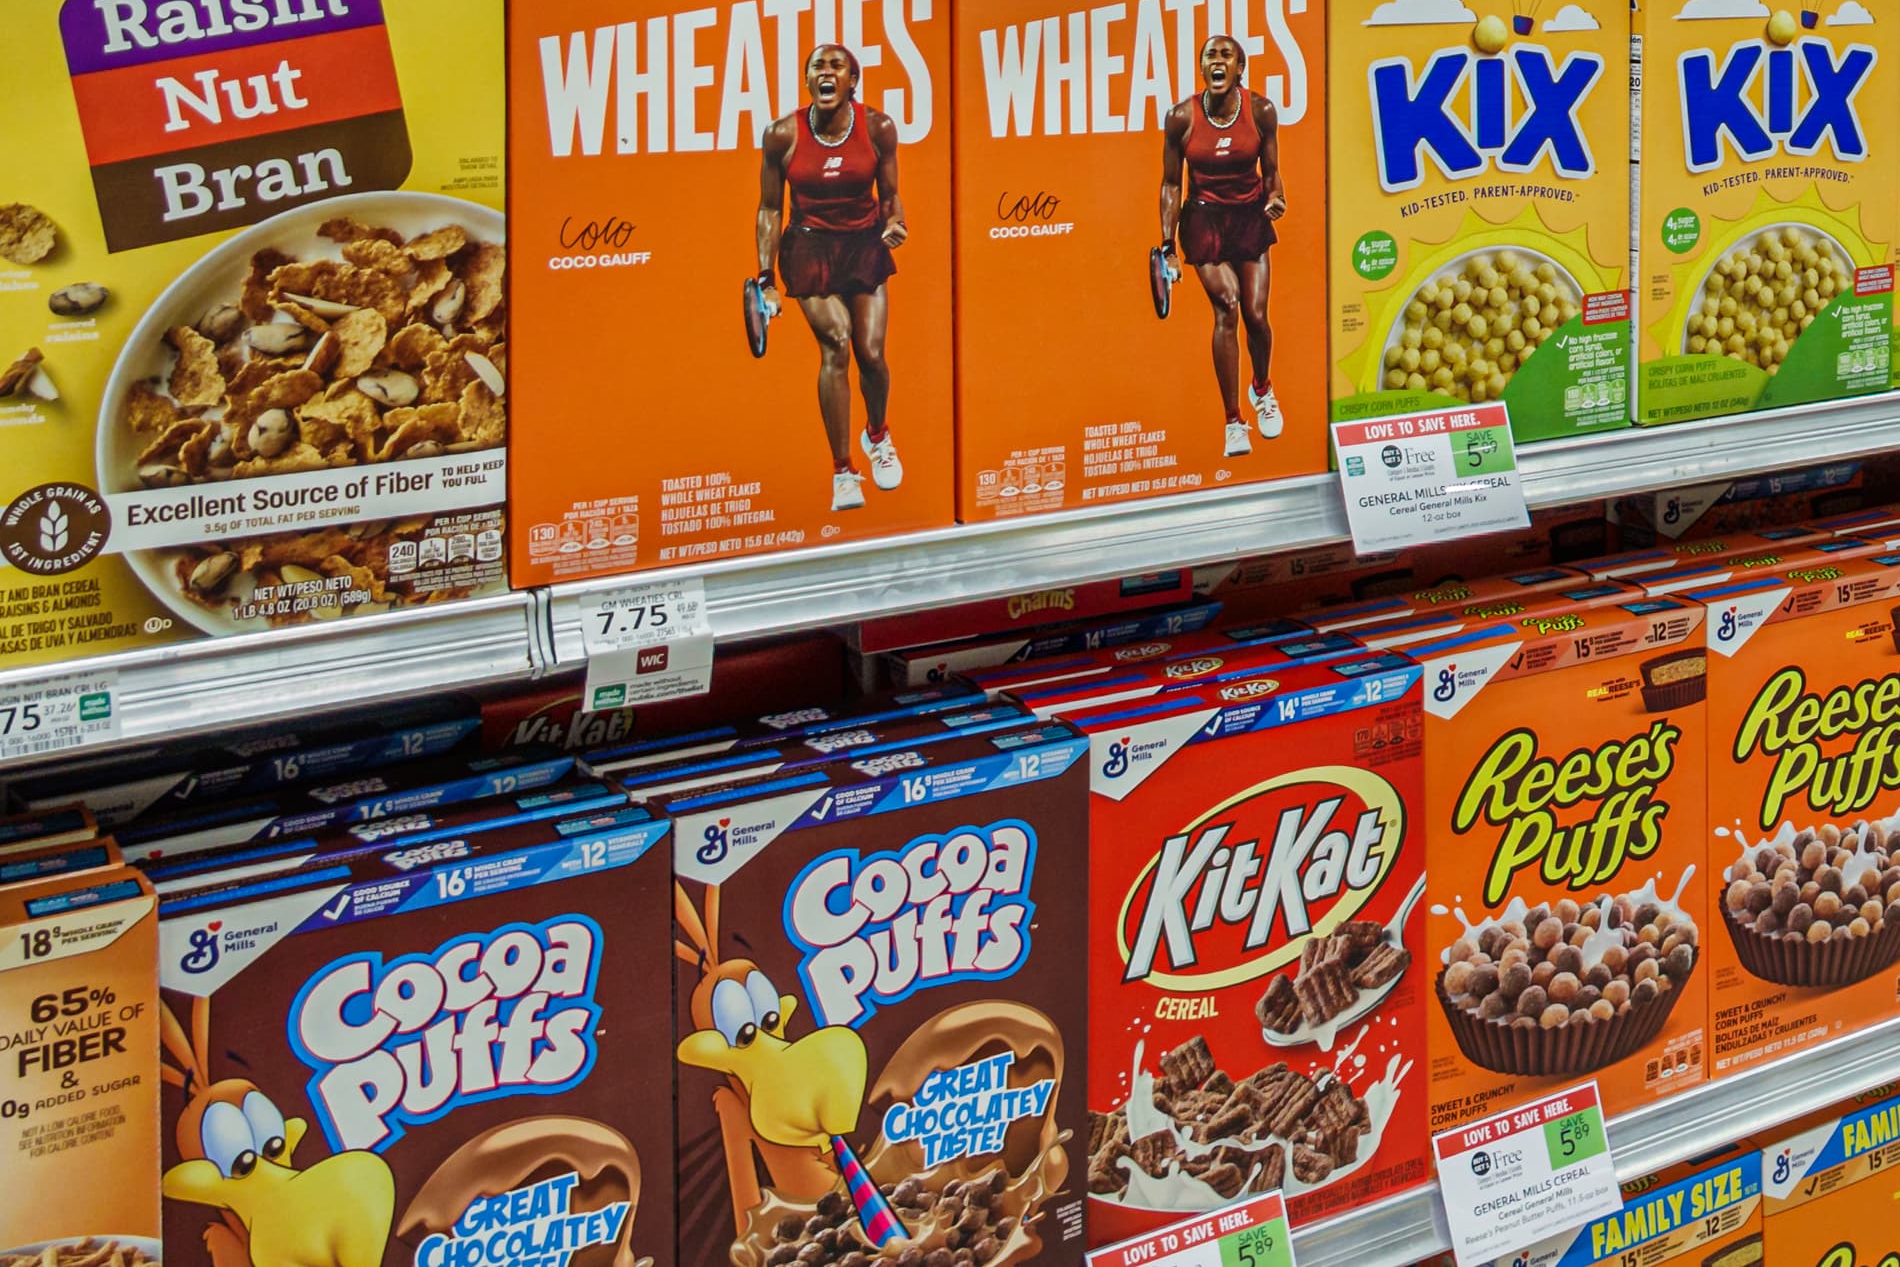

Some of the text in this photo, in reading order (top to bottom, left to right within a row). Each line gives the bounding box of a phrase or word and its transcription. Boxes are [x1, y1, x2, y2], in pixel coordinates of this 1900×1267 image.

[155, 60, 308, 133] Nut
[154, 146, 352, 221] Bran
[1400, 184, 1578, 219] KID-TESTED. PARENT-APPROVED.
[549, 252, 651, 270] COCO GAUFF
[442, 459, 505, 477] TO HELP KEEP
[442, 474, 487, 489] YOU FULL
[6, 487, 102, 526] WHOLE GRAIN AS
[128, 471, 434, 527] Excellent Source of Fiber
[28, 531, 102, 570] INGREDIENT
[597, 604, 669, 634] 7.75
[1454, 721, 1680, 834] Reese's
[1484, 787, 1667, 906] Puffs
[30, 986, 116, 1024] 65%
[301, 924, 594, 1061] Cocoa
[1154, 995, 1219, 1022] CEREAL
[1715, 994, 1786, 1020] SWEET & CRUNCHY
[0, 1003, 145, 1052] DAILY VALUE OF
[1715, 1010, 1763, 1031] CORN PUFFS
[18, 1026, 127, 1078] FIBER
[915, 1053, 1013, 1107] GREAT
[884, 1081, 1052, 1141] CHOCOLATEY
[922, 1122, 1006, 1168] TASTE!
